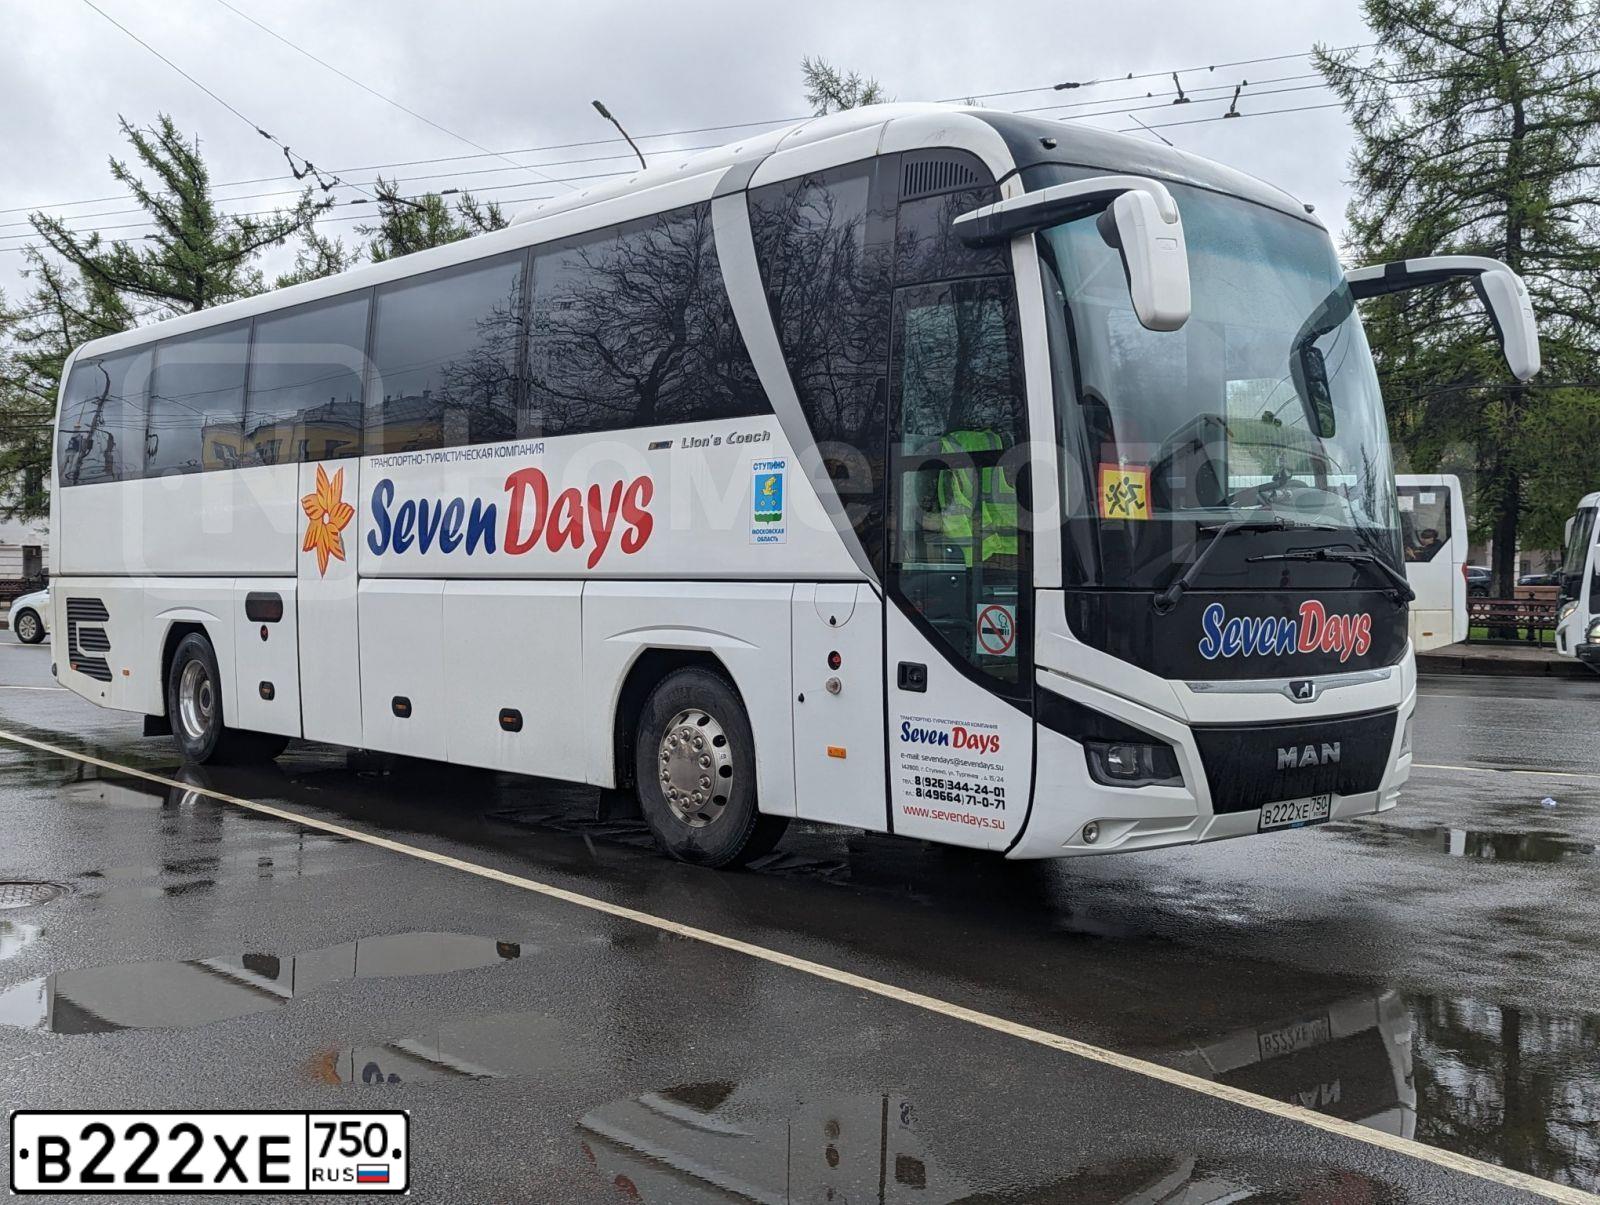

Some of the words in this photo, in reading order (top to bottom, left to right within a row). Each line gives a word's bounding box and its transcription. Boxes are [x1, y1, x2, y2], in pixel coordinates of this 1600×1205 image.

[681, 433, 722, 449] Lion's
[726, 430, 771, 444] Coach
[370, 448, 493, 469] ТРАНСПОРТНО-ТУРИСТИЧЕСКАЯ
[495, 442, 545, 458] КОМПАНИЯ
[753, 461, 785, 471] СТУПИНО
[921, 755, 1004, 771] sevendays@sevendays.su
[1277, 742, 1341, 770] MAN
[914, 776, 1005, 798] 8(926)344-24-01
[1311, 796, 1327, 812] 750
[903, 805, 1005, 830] www.sevendays.su
